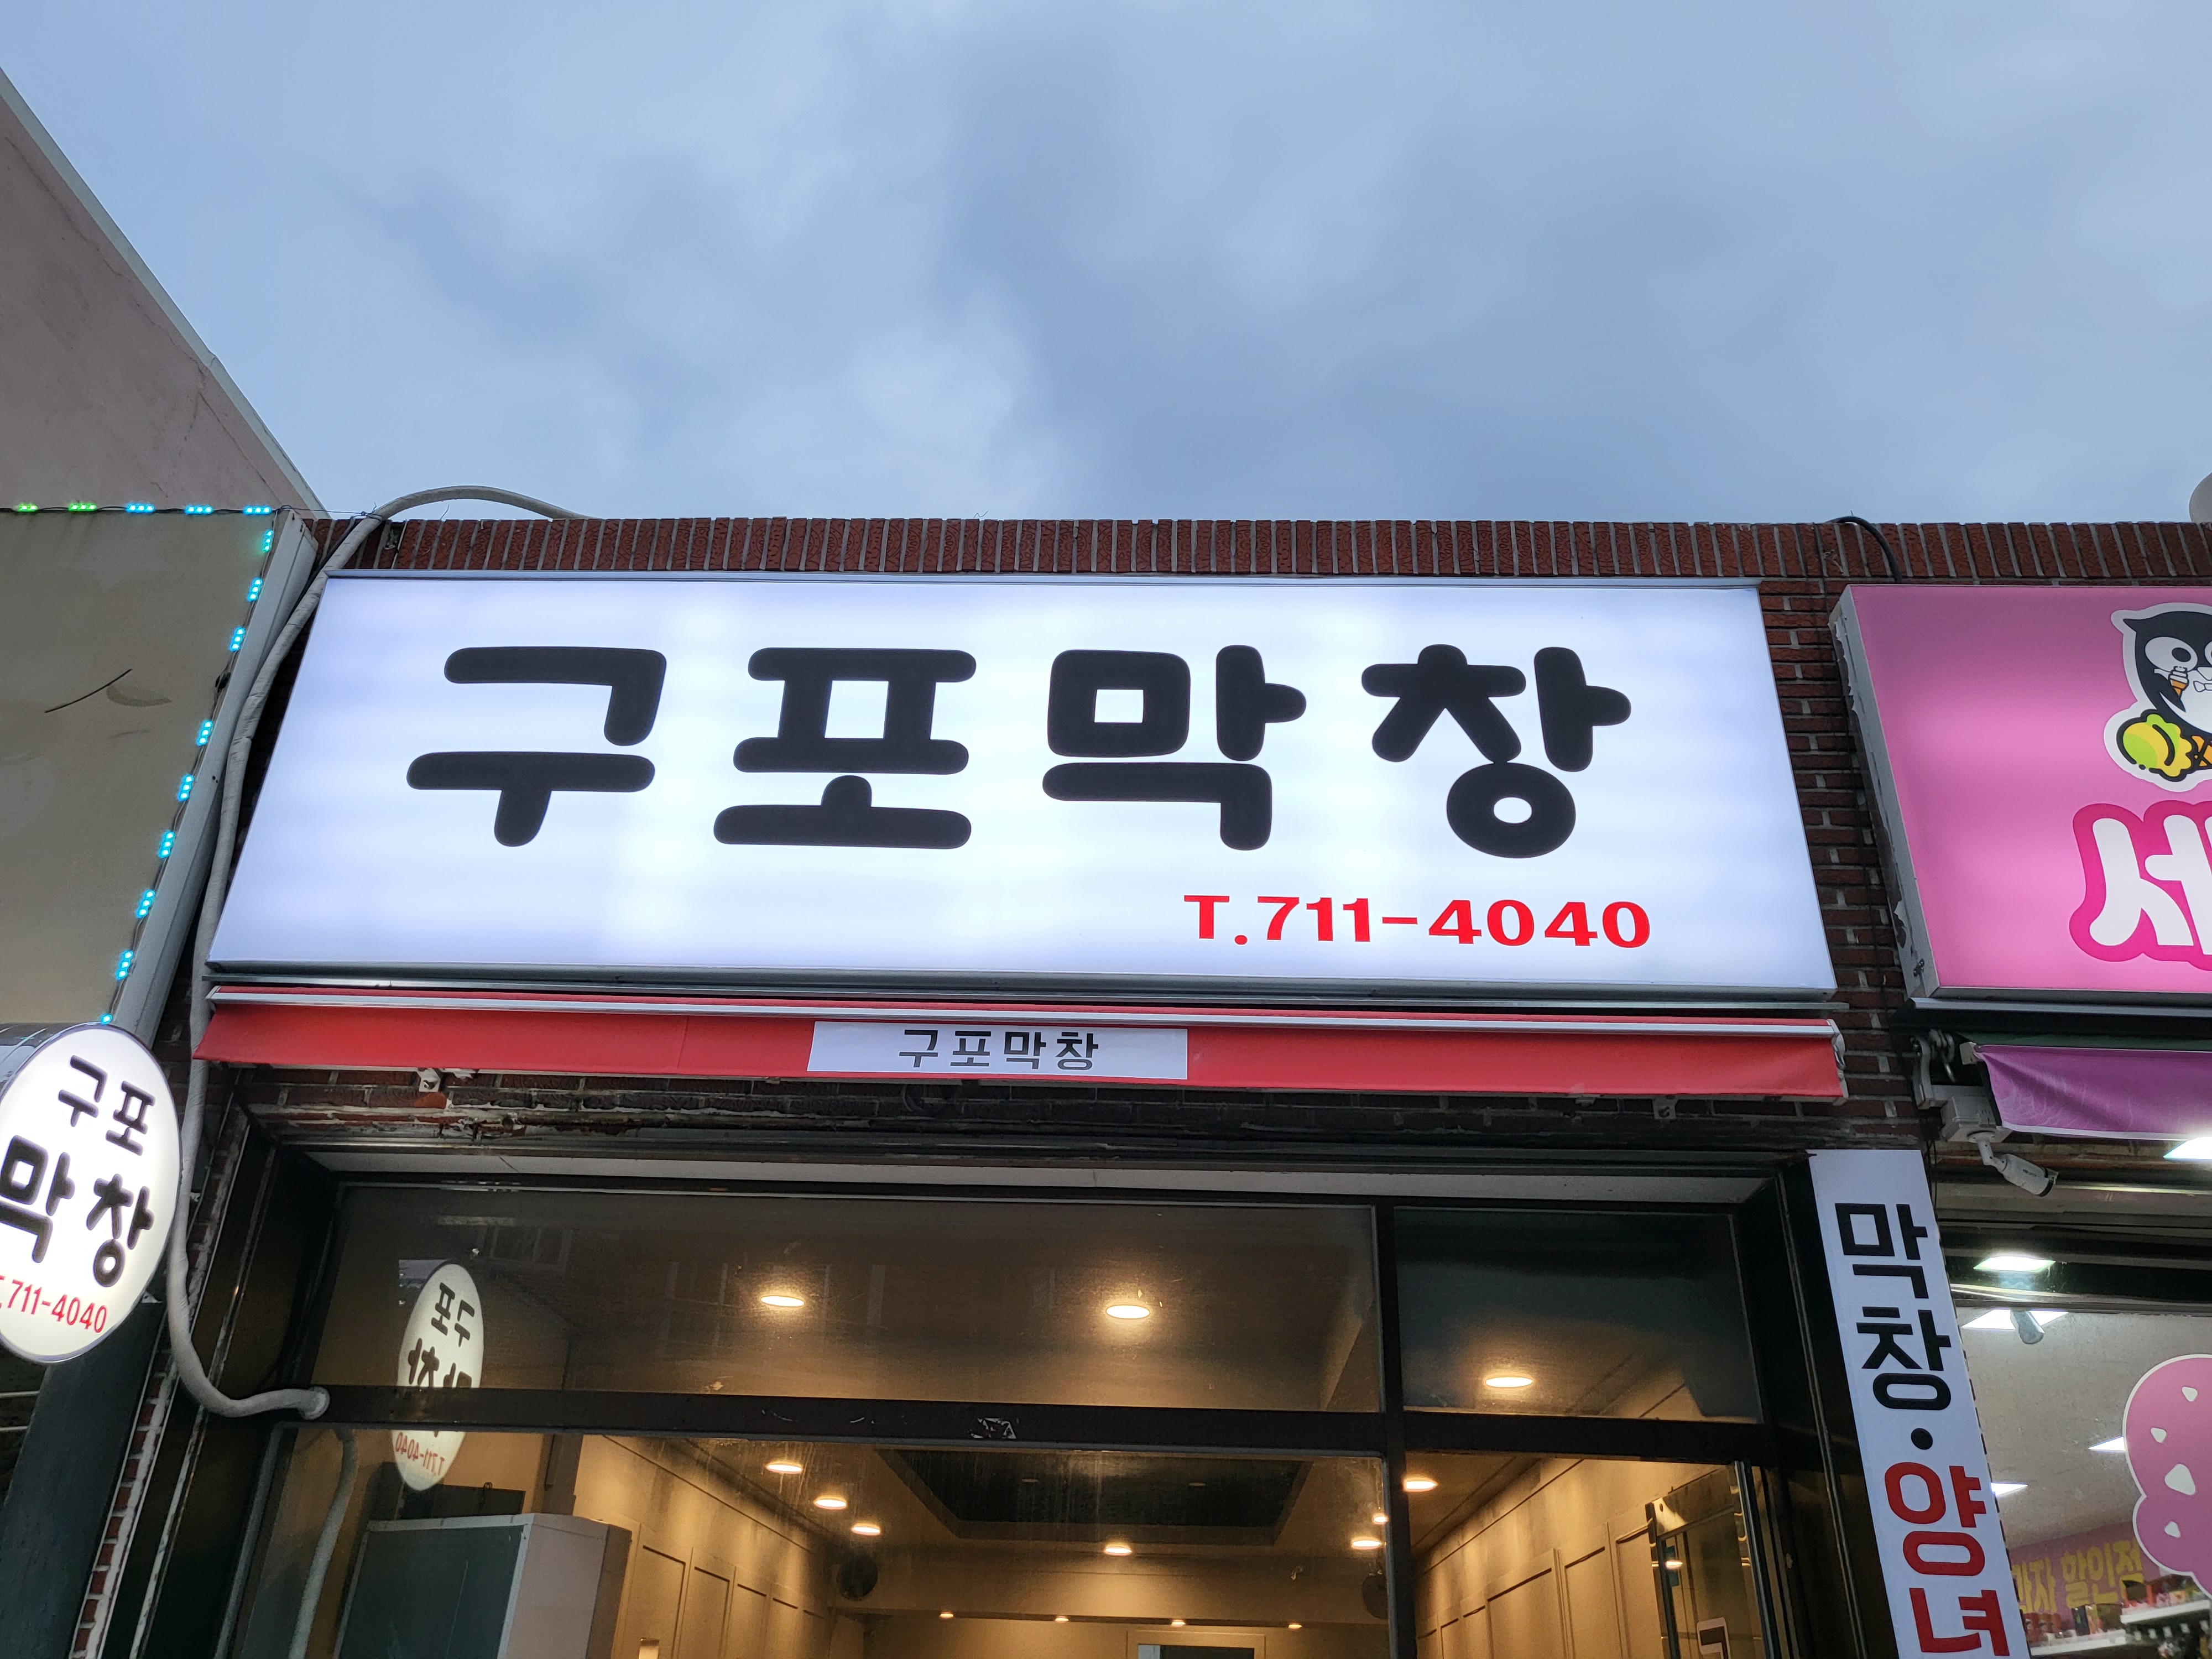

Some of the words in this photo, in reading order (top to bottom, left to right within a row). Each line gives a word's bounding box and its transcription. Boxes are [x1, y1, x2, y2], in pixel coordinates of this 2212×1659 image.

[406, 644, 1631, 859] 구포막창
[1183, 895, 1650, 948] T.711-4040
[899, 1029, 1099, 1071] 구포막창
[58, 1055, 156, 1156] 구포
[0, 1135, 154, 1287] 막창
[0, 1275, 107, 1333] .711-4040
